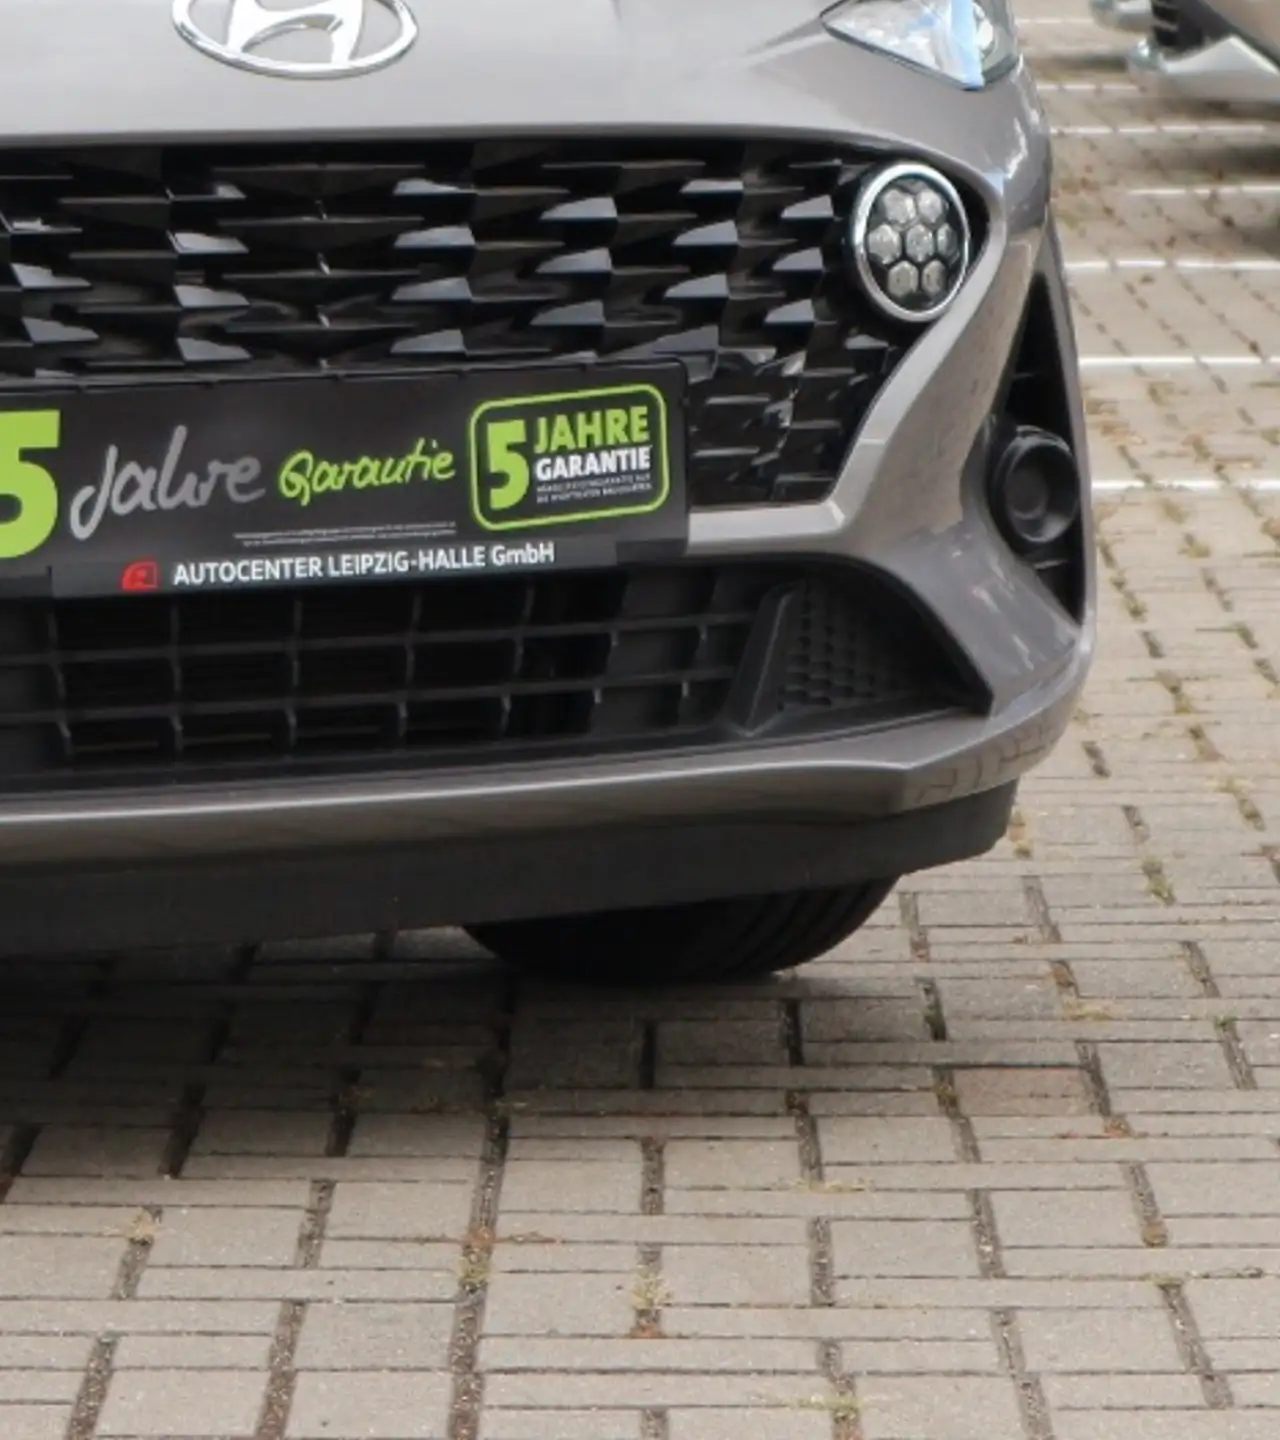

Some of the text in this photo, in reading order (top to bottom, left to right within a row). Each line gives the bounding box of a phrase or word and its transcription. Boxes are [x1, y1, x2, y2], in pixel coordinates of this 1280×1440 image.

[69, 424, 267, 542] Jahre
[279, 436, 457, 507] Garantie
[487, 405, 650, 510] 5 JAHRE
[535, 444, 653, 482] GARANTIE
[173, 541, 555, 587] AUTOCENTER LEIPZIG-HALLE GmbH
